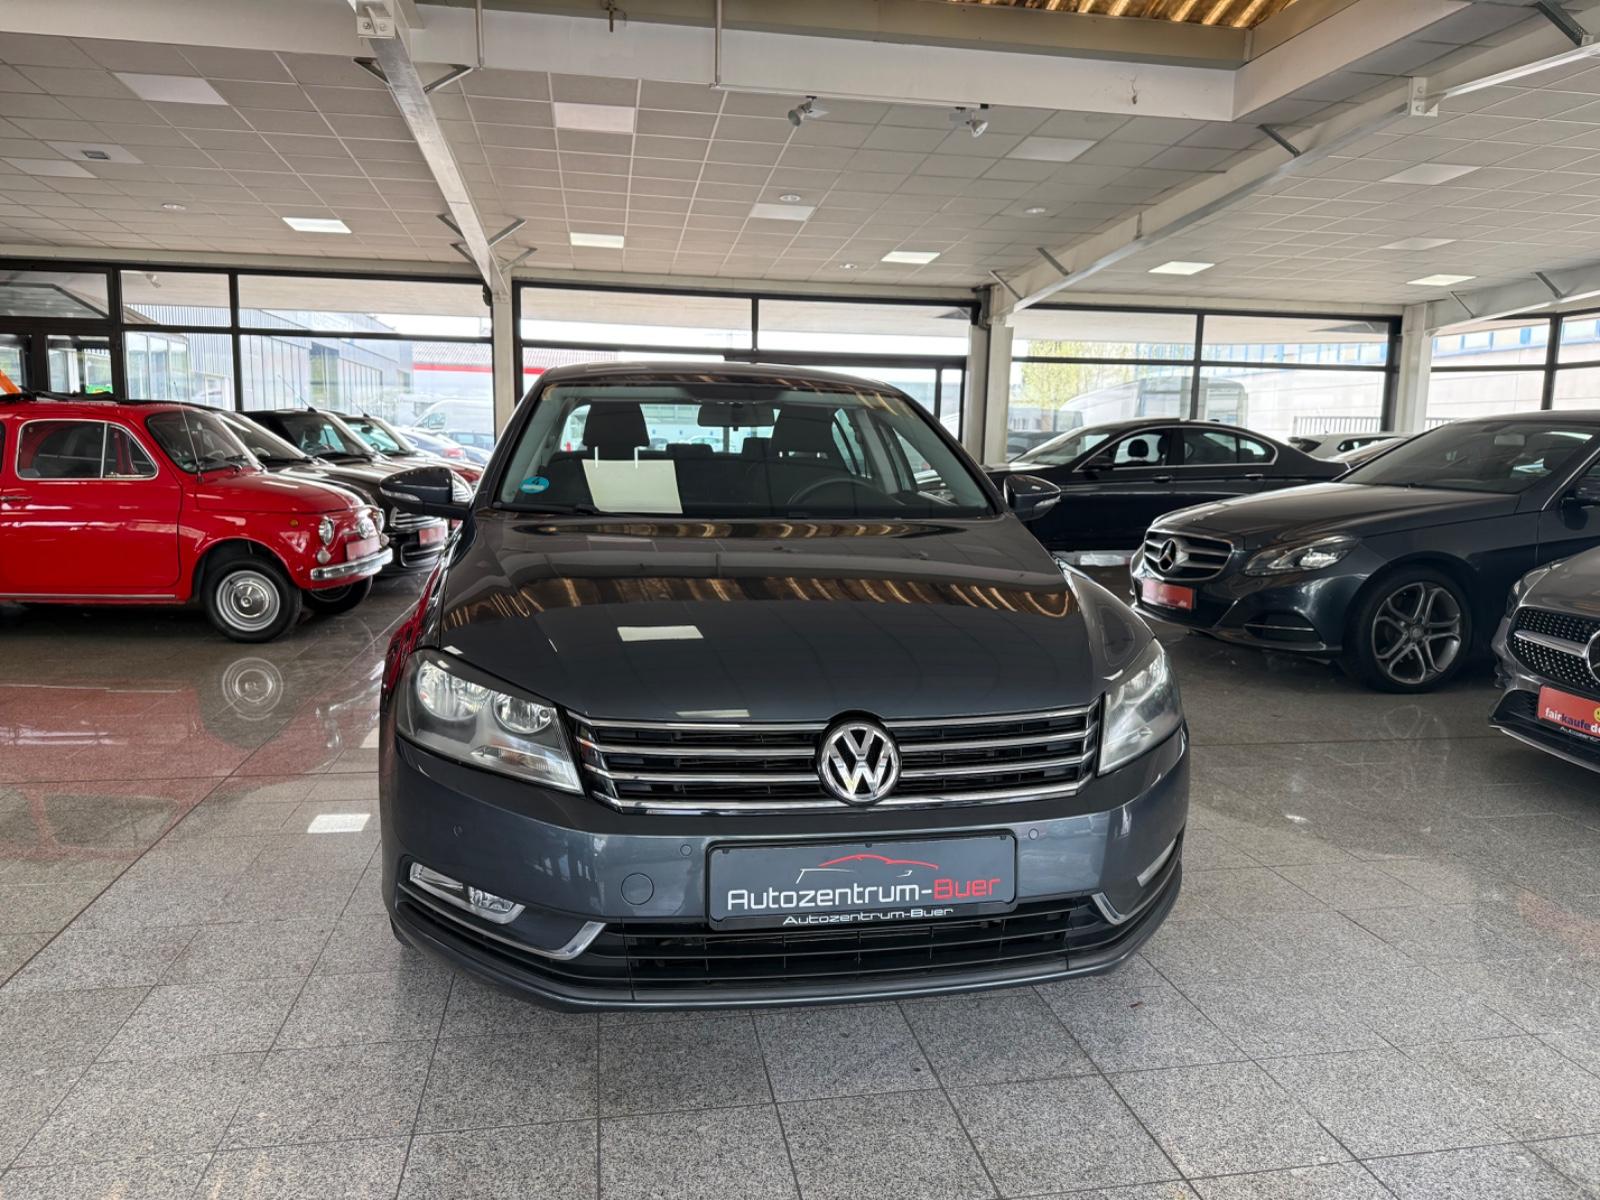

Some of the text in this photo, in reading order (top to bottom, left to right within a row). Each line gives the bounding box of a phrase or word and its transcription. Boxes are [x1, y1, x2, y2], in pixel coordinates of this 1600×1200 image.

[1545, 707, 1600, 734] fairkaufed
[728, 878, 1001, 911] Autozentrum-Buer
[782, 908, 954, 926] Autozentrum-Buer
